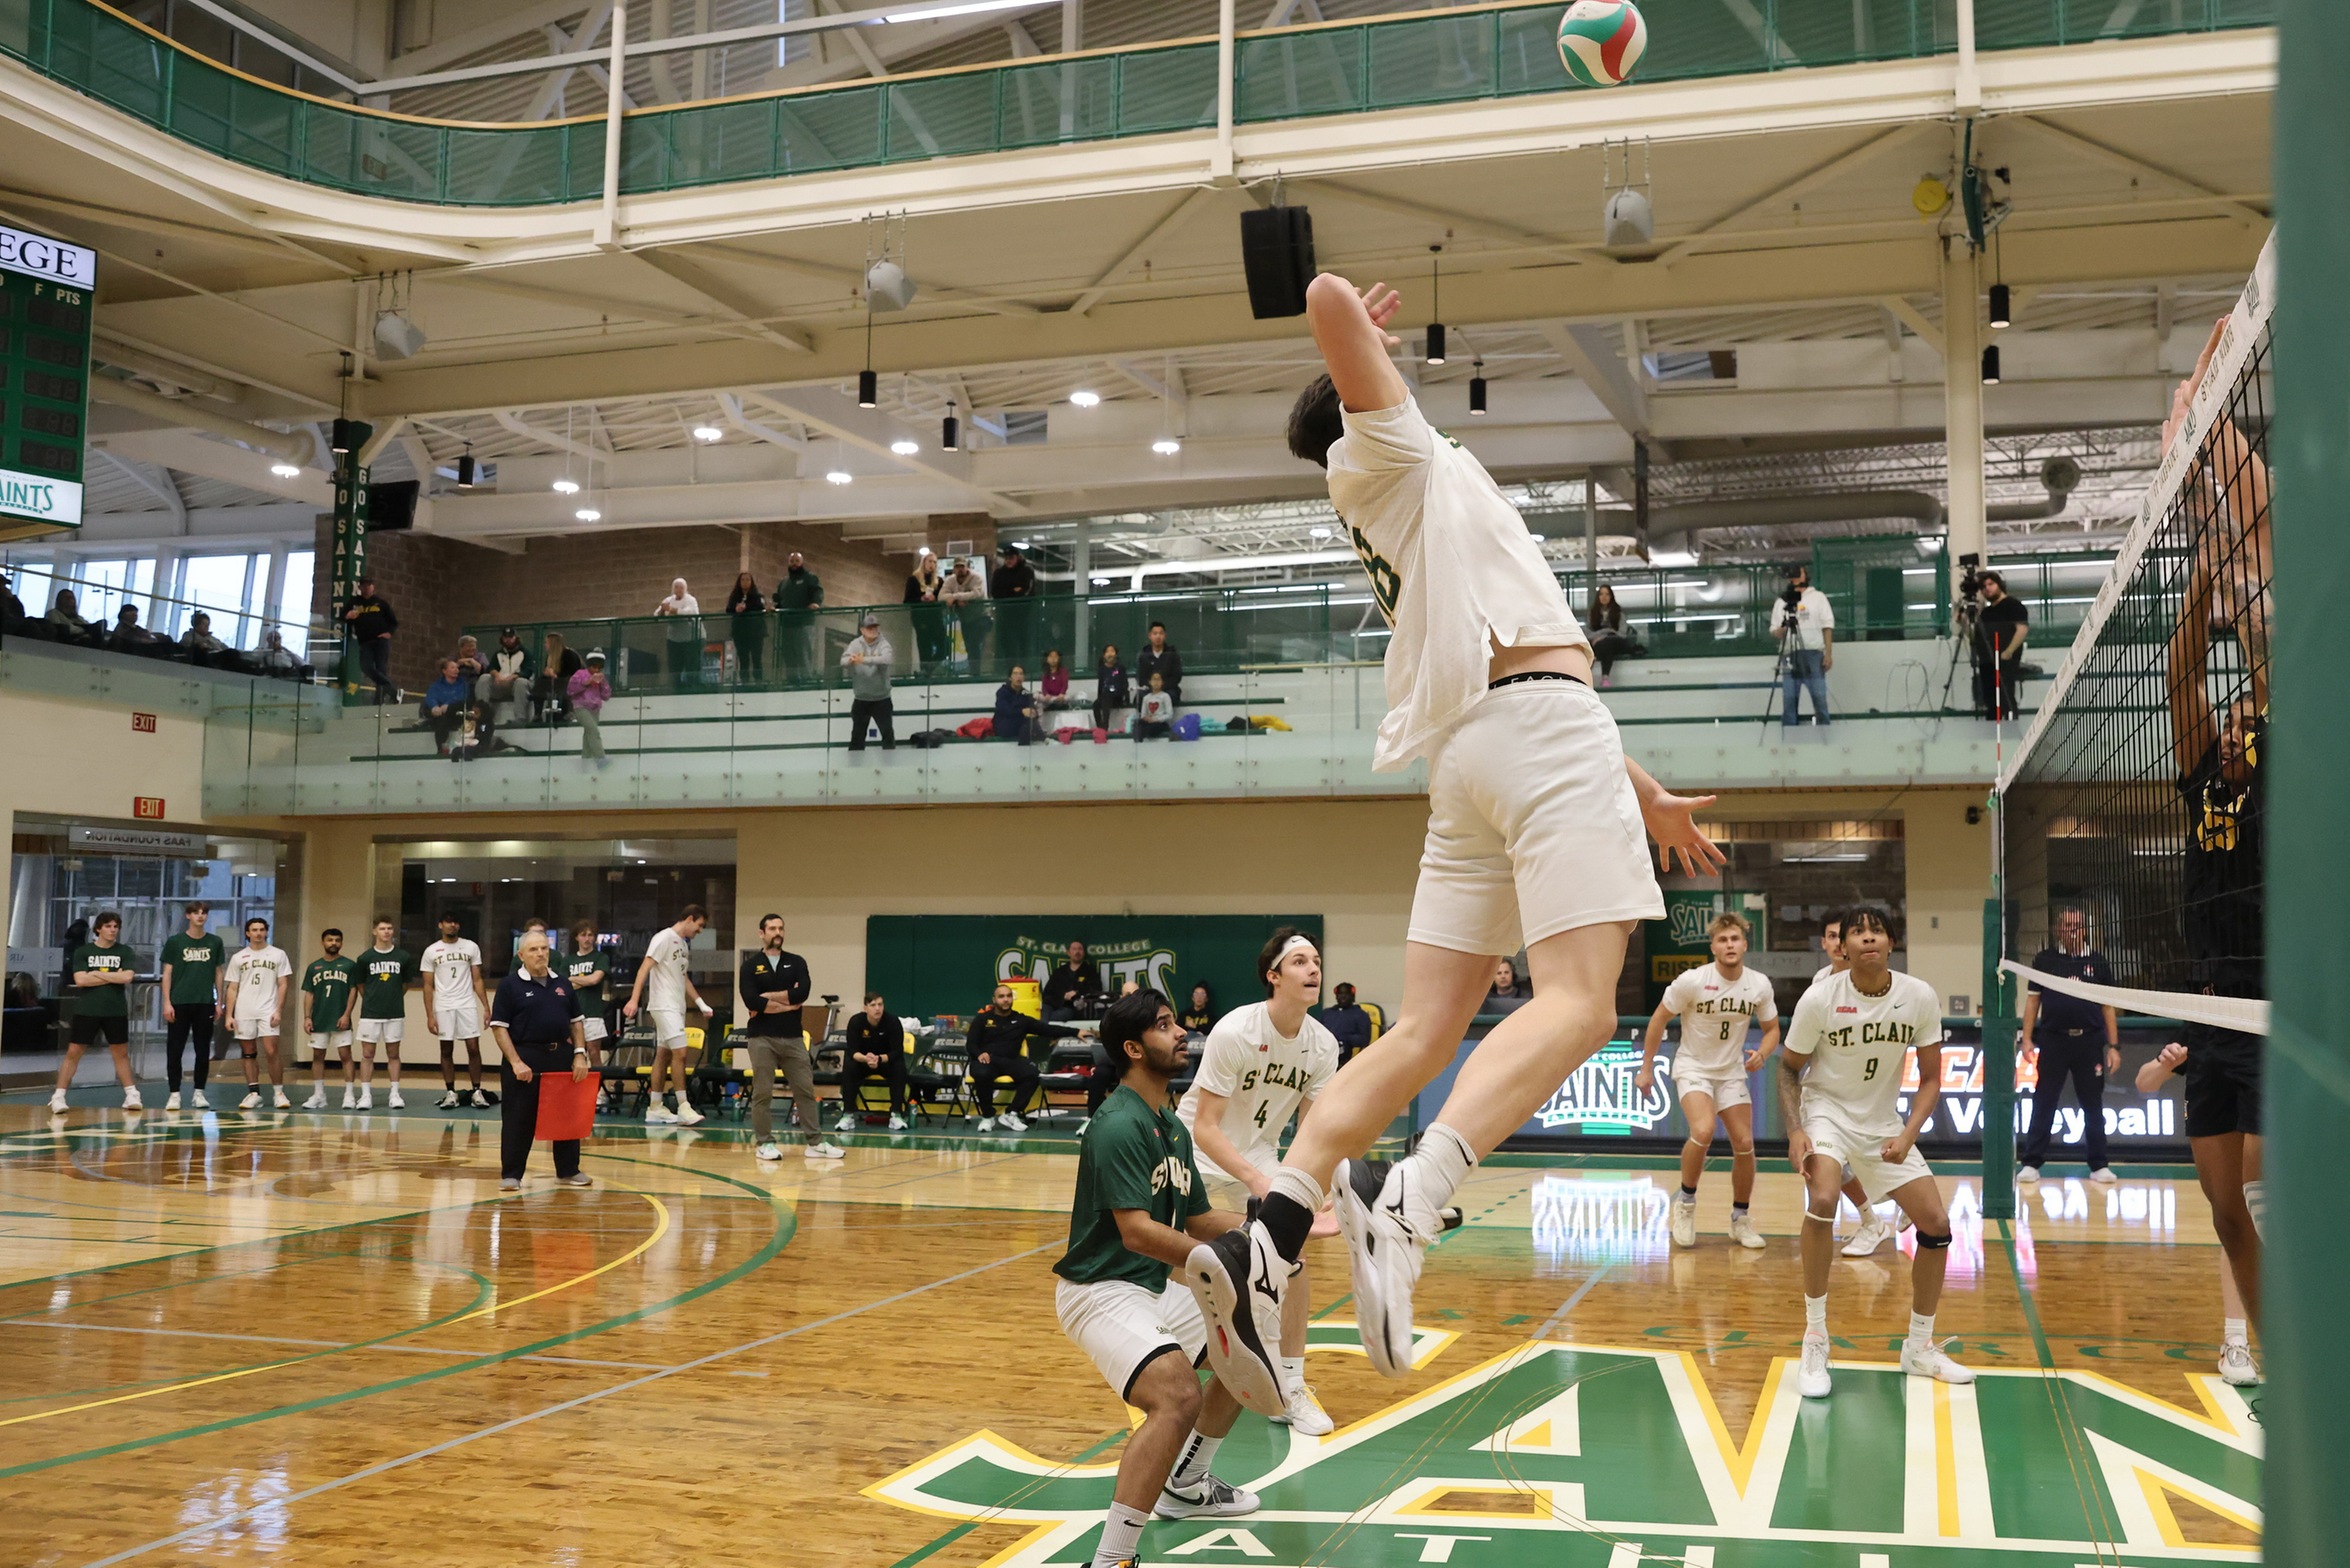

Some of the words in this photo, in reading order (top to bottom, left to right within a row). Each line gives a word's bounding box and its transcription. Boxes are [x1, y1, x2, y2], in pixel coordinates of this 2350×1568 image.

[0, 232, 77, 278] EGE
[35, 283, 43, 295] F
[56, 288, 81, 305] PTS
[358, 469, 367, 505] GO
[134, 715, 155, 731] EXIT
[140, 798, 160, 817] EXIT
[1016, 936, 1038, 950] ST.
[1042, 941, 1069, 954] CLA
[1087, 939, 1151, 954] COLLEGE
[88, 955, 121, 968] SAINTS
[252, 959, 276, 971] CLAIR
[369, 961, 401, 975] SAINTS
[323, 970, 348, 983] CLAIR
[451, 967, 457, 978] 2
[326, 984, 332, 998] 7
[1697, 1000, 1715, 1014] ST.
[1720, 1021, 1730, 1040] 8
[1828, 1026, 1855, 1047] ST.
[1602, 1049, 1645, 1061] COLLEG
[1863, 1058, 1879, 1081] 9
[1254, 1100, 1269, 1128] 4
[1946, 1097, 2174, 1144] Vlyall
